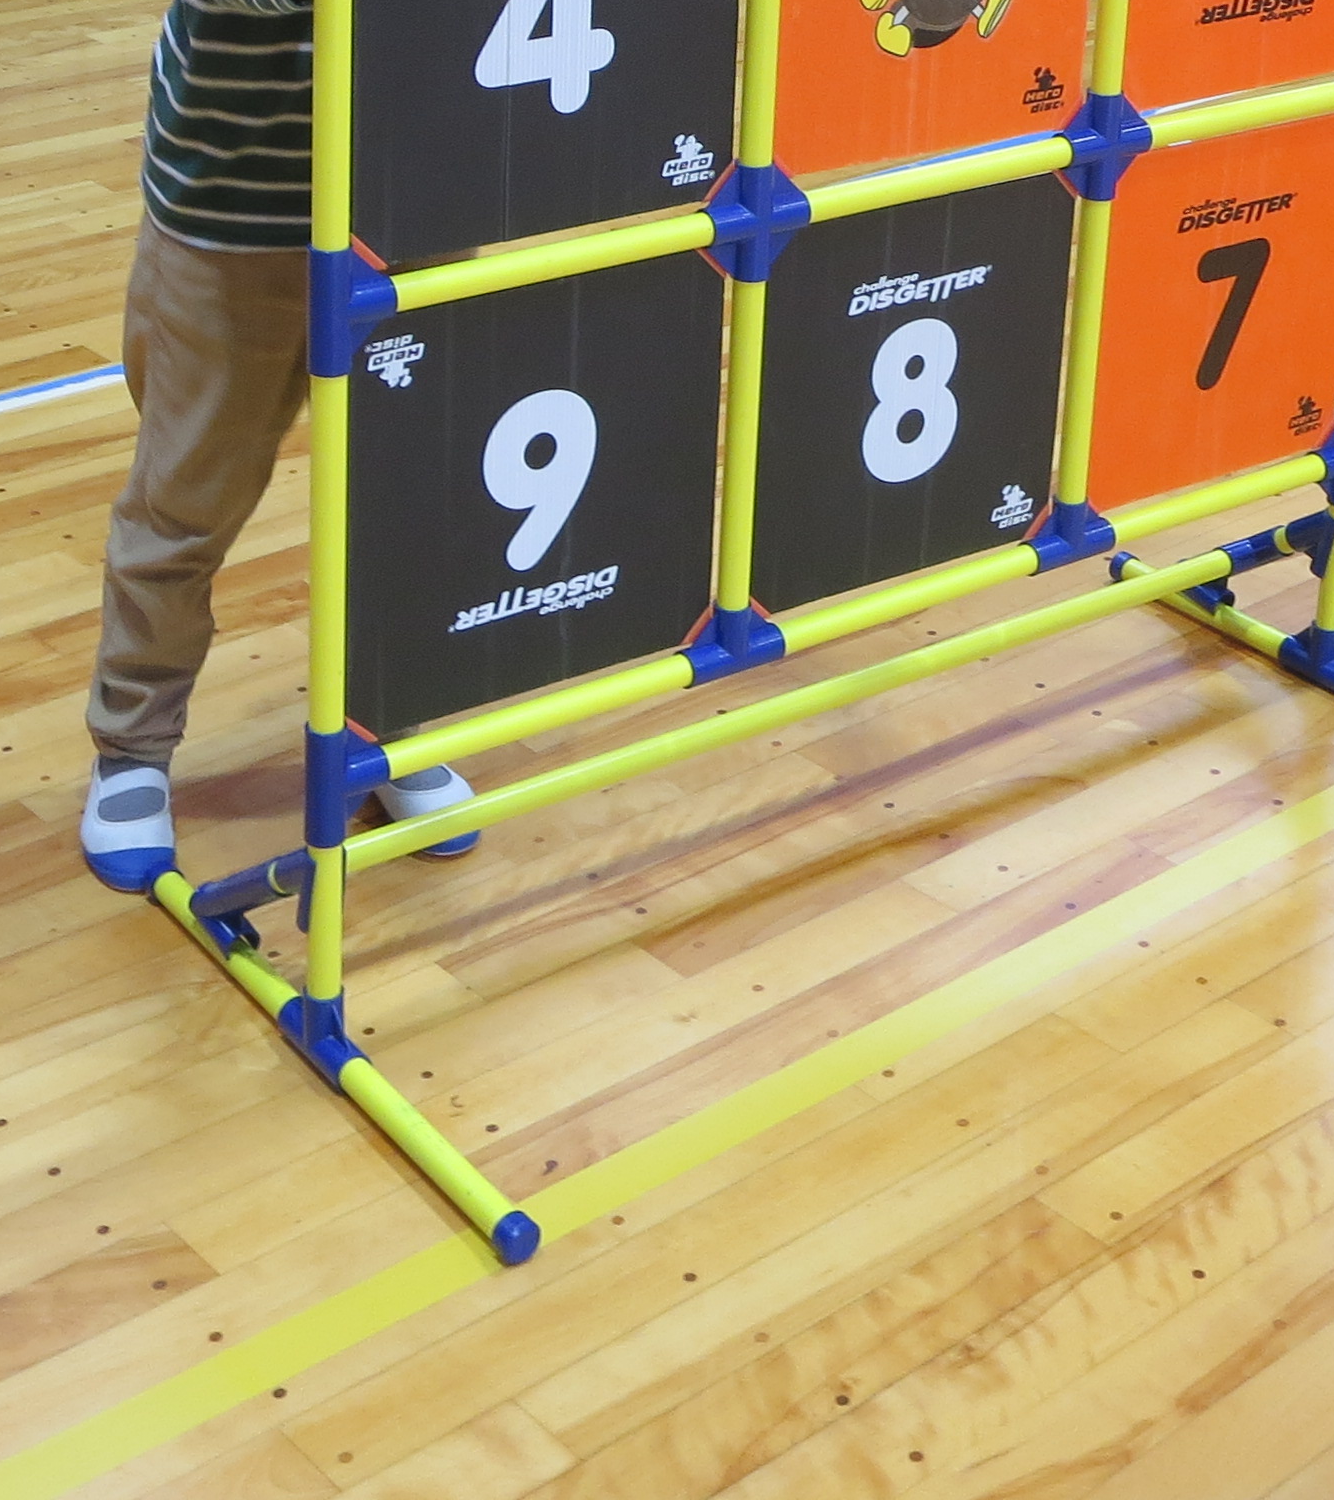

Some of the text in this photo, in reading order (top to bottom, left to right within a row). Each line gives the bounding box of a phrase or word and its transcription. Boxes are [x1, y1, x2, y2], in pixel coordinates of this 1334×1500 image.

[1024, 86, 1062, 103] Hero
[665, 156, 711, 175] Hero
[853, 273, 919, 296] challenge
[1196, 238, 1270, 390] 7
[862, 318, 958, 483] 8
